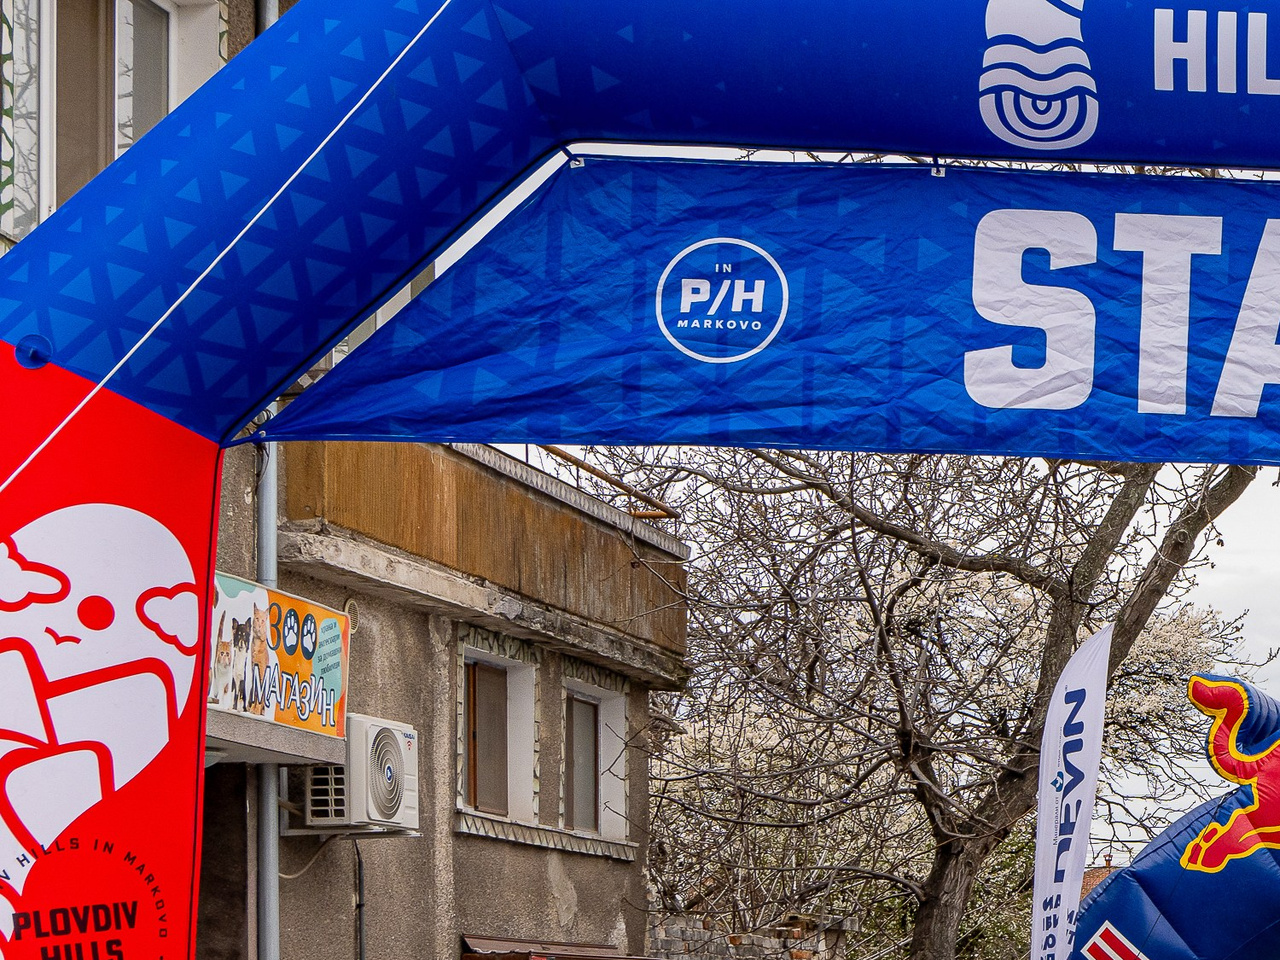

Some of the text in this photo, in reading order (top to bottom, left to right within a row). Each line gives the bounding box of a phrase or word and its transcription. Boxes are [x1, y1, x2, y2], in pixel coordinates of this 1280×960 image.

[715, 263, 732, 273] IN
[679, 278, 766, 316] P/H
[677, 319, 762, 331] MARKOVO
[252, 662, 336, 728] МАГАЗИН
[94, 838, 115, 855] IN
[123, 851, 168, 938] MARKOVO
[12, 900, 138, 941] PLOVDIV
